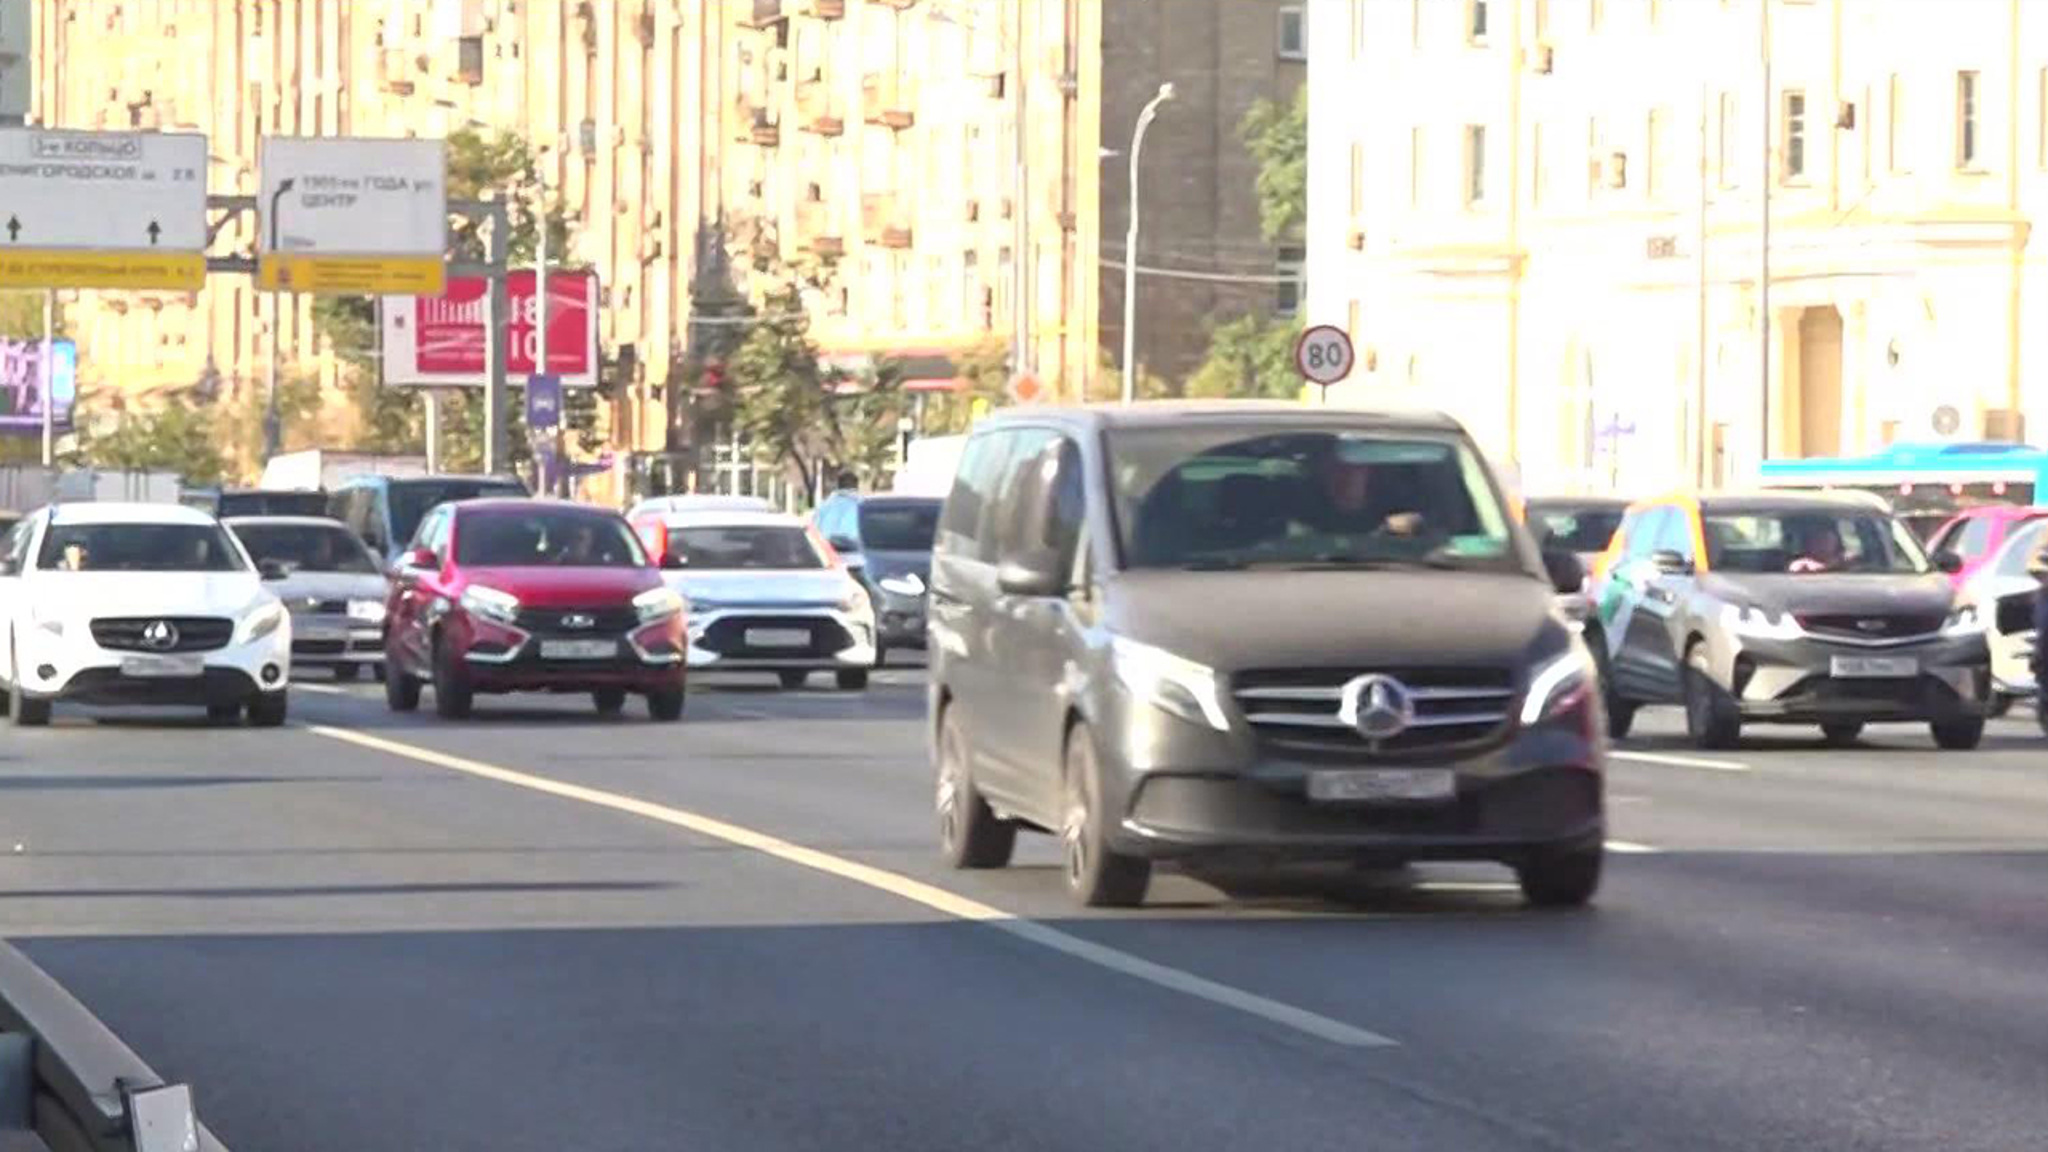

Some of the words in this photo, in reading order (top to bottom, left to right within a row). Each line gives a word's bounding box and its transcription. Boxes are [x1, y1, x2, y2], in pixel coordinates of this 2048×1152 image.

[364, 175, 408, 191] ГОДА
[301, 194, 358, 208] ЦЕНТР
[1308, 342, 1342, 369] 80
